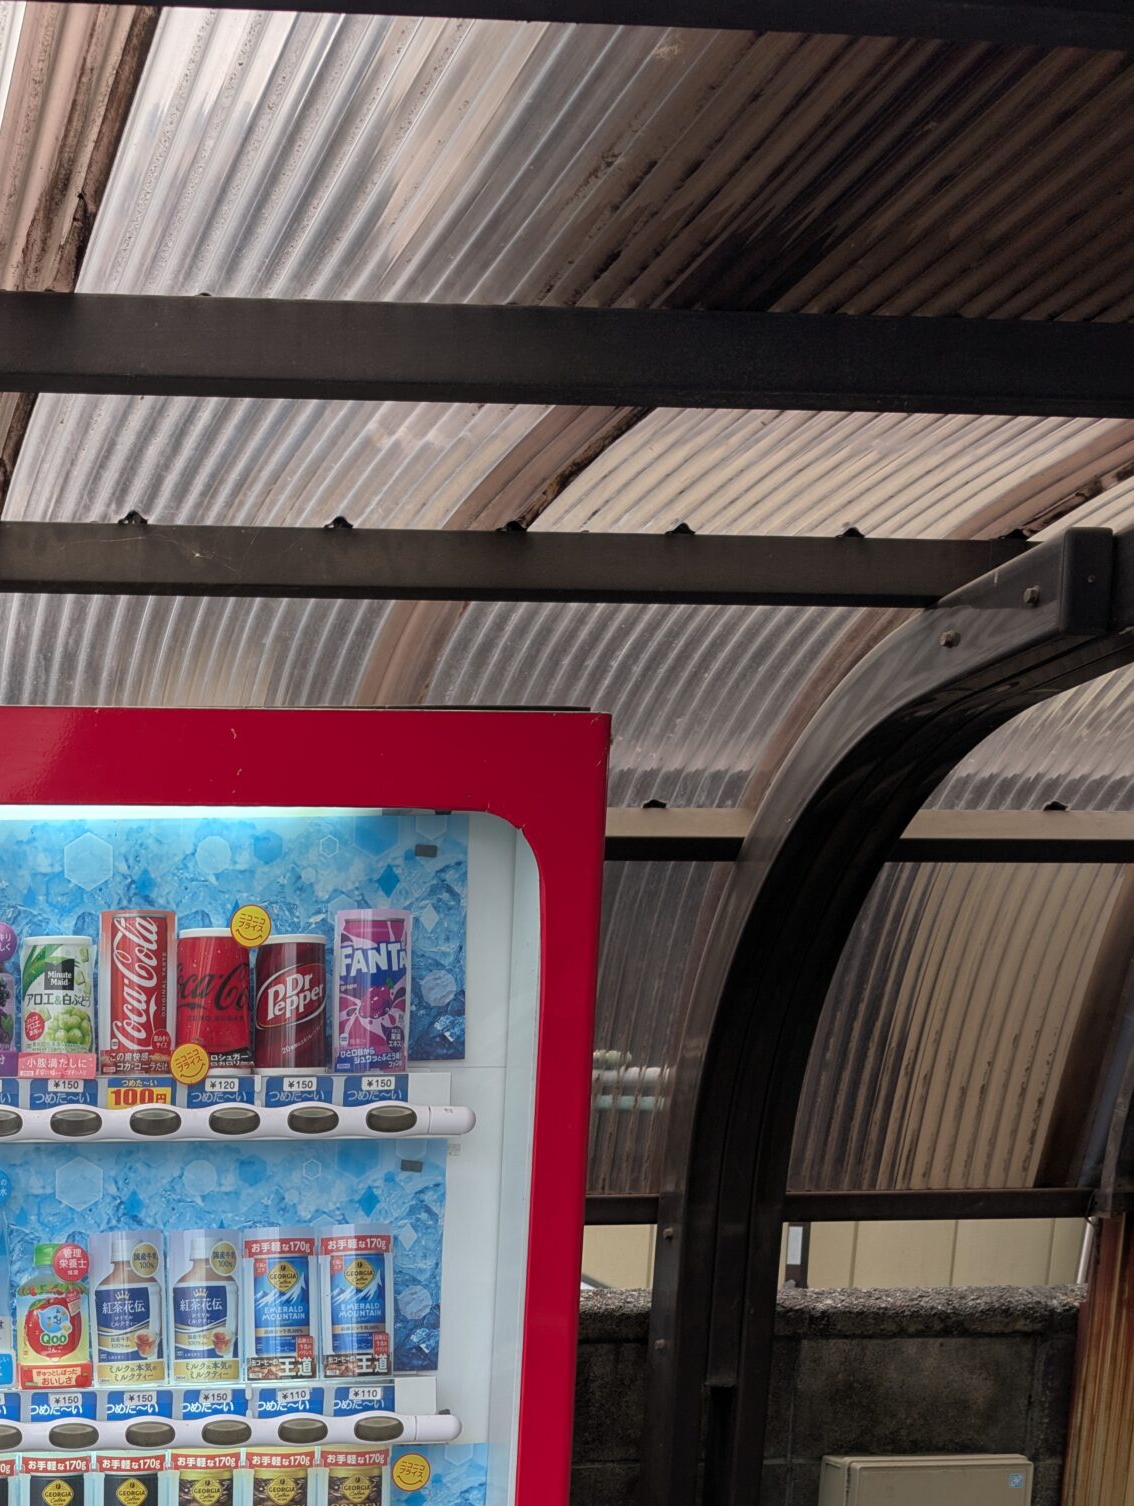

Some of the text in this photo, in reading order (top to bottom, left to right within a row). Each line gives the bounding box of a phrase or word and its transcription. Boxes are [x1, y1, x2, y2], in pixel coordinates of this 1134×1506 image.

[47, 970, 72, 979] Minute
[50, 978, 69, 986] Maid
[113, 916, 158, 1049] Coca-Cola
[285, 973, 313, 991] Dr
[267, 984, 324, 1020] Pepper
[53, 1080, 79, 1089] ¥150
[210, 1080, 236, 1090] ¥120
[287, 1080, 313, 1090] ¥150
[110, 1087, 167, 1106] 100円
[251, 1241, 311, 1253] お手軽な170g
[328, 1238, 387, 1250] お手軽な170g
[63, 1248, 82, 1258] 管理
[58, 1259, 87, 1269] 栄養士
[102, 1304, 146, 1315] 紅茶花伝
[180, 1299, 223, 1311] 紅茶花伝
[265, 1305, 303, 1314] EMERALD
[341, 1302, 380, 1311] EMERALD
[262, 1313, 305, 1321] MOUNTAIN
[338, 1309, 381, 1317] MOUNTAIN
[40, 1333, 68, 1346] Qoo
[279, 1357, 312, 1377] 王道
[356, 1354, 388, 1373] 王道
[35, 1368, 80, 1377] ぎゅっとしぼった
[114, 1373, 154, 1382] ミルクティー
[41, 1376, 73, 1386] おいしさ
[282, 1391, 306, 1400] ¥110
[353, 1390, 377, 1398] ¥110
[401, 1460, 426, 1470] ニコニコ
